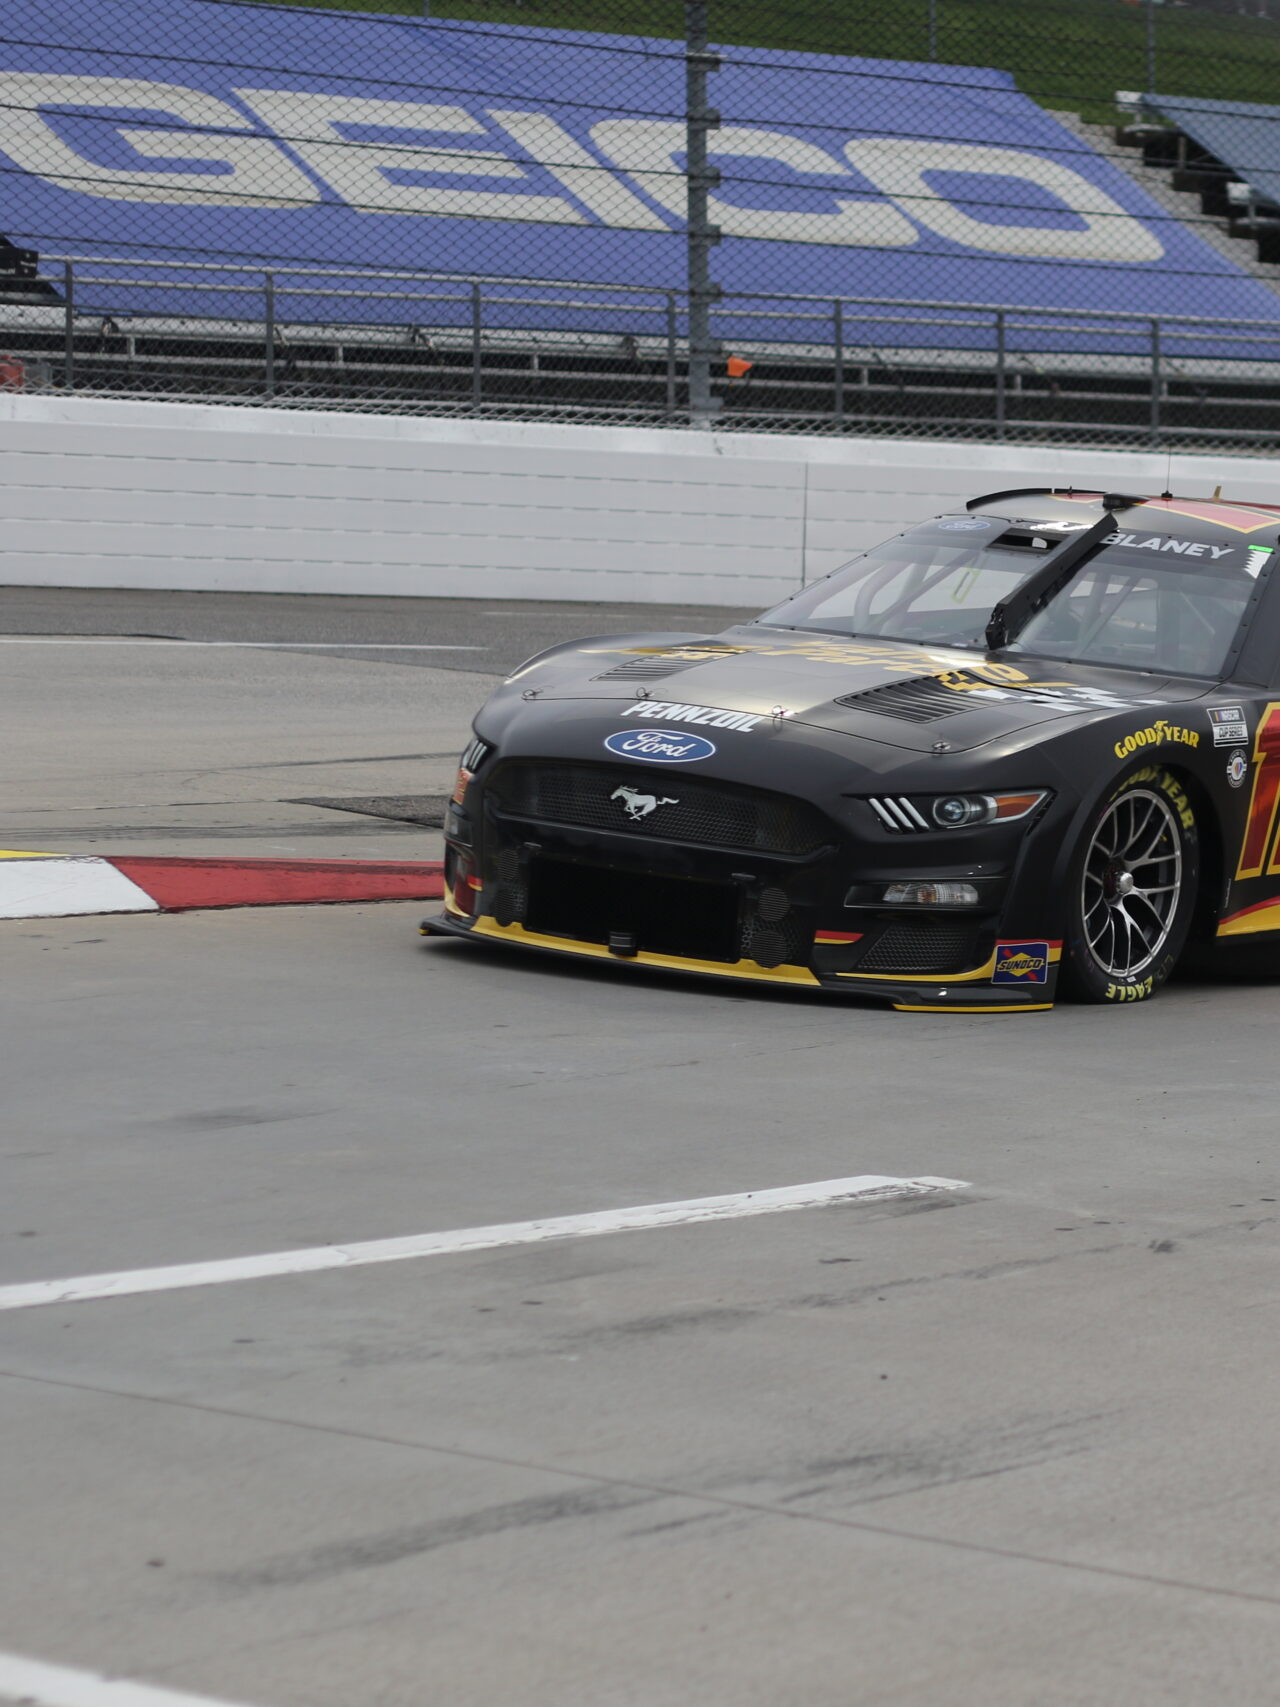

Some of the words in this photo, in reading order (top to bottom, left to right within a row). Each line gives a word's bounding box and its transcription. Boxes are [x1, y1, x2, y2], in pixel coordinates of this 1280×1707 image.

[0, 71, 1164, 262] GEICO
[1100, 533, 1235, 560] BLANEY
[620, 700, 762, 733] PENNZOIL
[619, 732, 696, 760] Ford
[999, 959, 1042, 971] SUNOCO
[1105, 975, 1153, 1001] EAGLE
